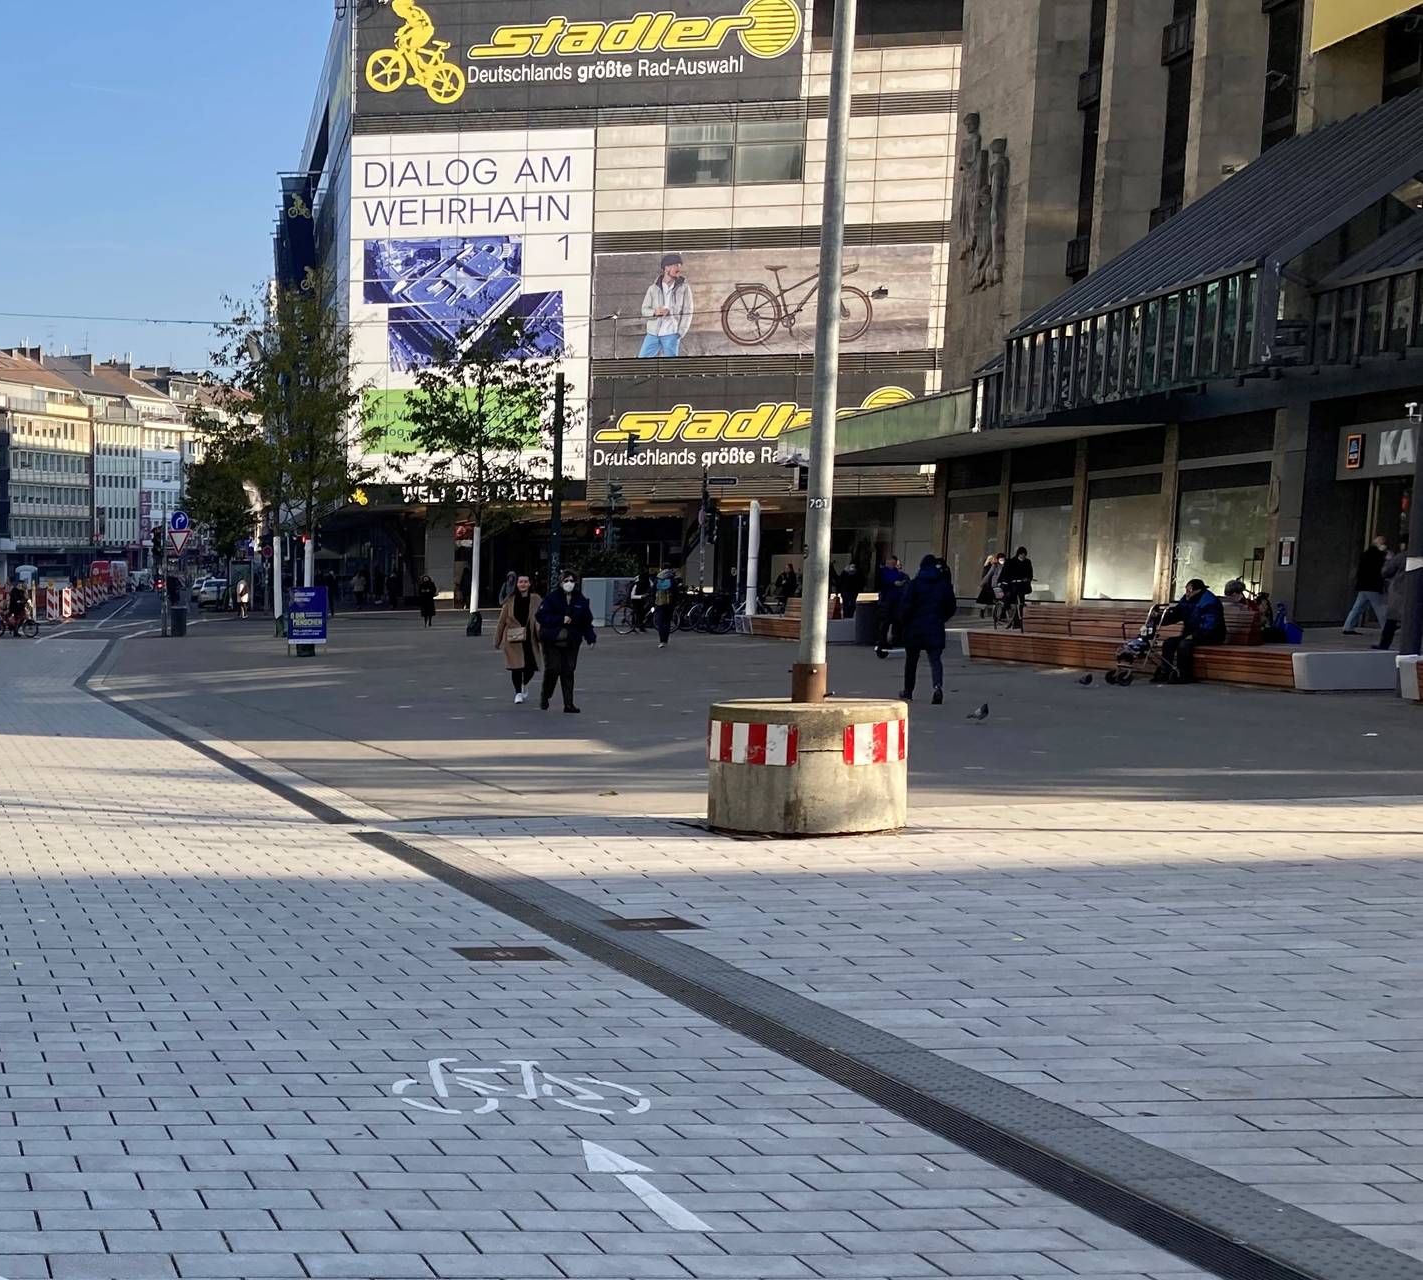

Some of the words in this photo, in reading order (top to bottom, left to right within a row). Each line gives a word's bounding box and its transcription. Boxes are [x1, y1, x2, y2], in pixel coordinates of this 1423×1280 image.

[468, 12, 756, 59] stadler
[467, 61, 572, 85] Deutschlands
[577, 55, 633, 84] größte
[637, 54, 744, 78] Rad-Auswahl
[364, 158, 498, 188] DIALOG
[514, 155, 571, 184] AM
[363, 194, 570, 227] WEHRHAHN
[558, 234, 569, 261] 1
[593, 448, 697, 467] Deutschlands
[701, 446, 756, 470] größte
[1378, 428, 1417, 466] KA
